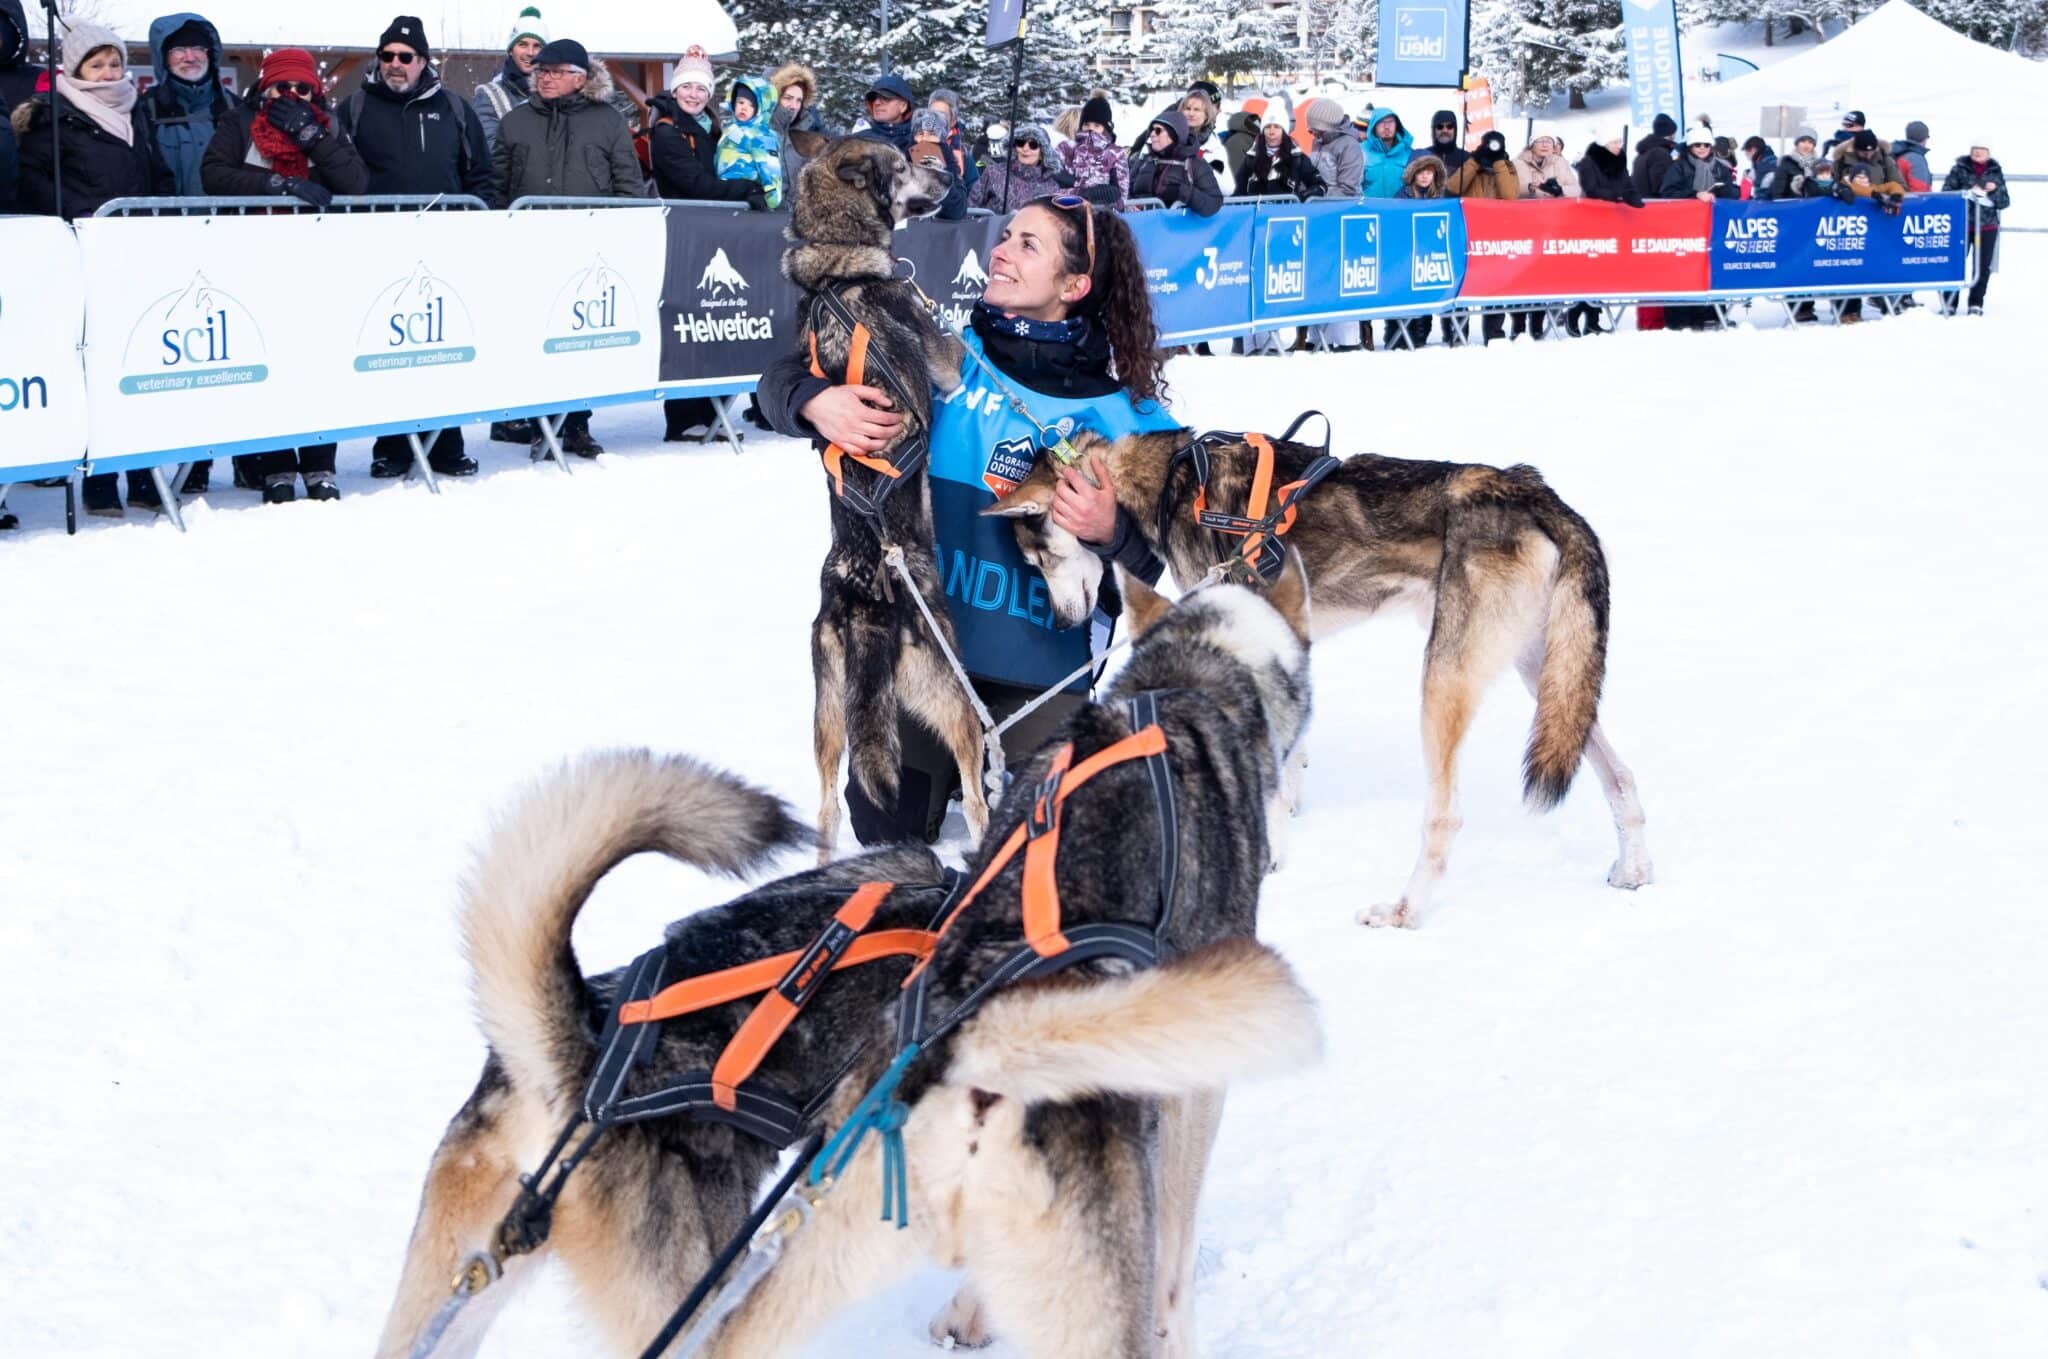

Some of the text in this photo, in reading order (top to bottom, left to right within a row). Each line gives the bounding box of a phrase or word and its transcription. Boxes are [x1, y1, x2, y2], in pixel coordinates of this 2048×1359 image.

[1726, 217, 1778, 239] ALPES
[1816, 215, 1868, 236] ALPES
[1902, 214, 1951, 234] ALPES
[1470, 240, 1483, 256] LE
[1543, 239, 1557, 255] LE
[1631, 238, 1647, 253] LE
[1735, 240, 1776, 253] IS HERE
[1826, 237, 1866, 250] IS HERE
[1914, 235, 1950, 248] IS HERE
[1343, 259, 1375, 289] bleu
[1415, 255, 1450, 283] bleu
[1268, 264, 1301, 295] bleu
[572, 285, 616, 330] scil
[388, 296, 445, 346] scil
[162, 309, 231, 366] scil
[367, 351, 463, 369] veterinary excellence
[136, 370, 253, 391] veterinary excellence
[993, 452, 1005, 463] LA
